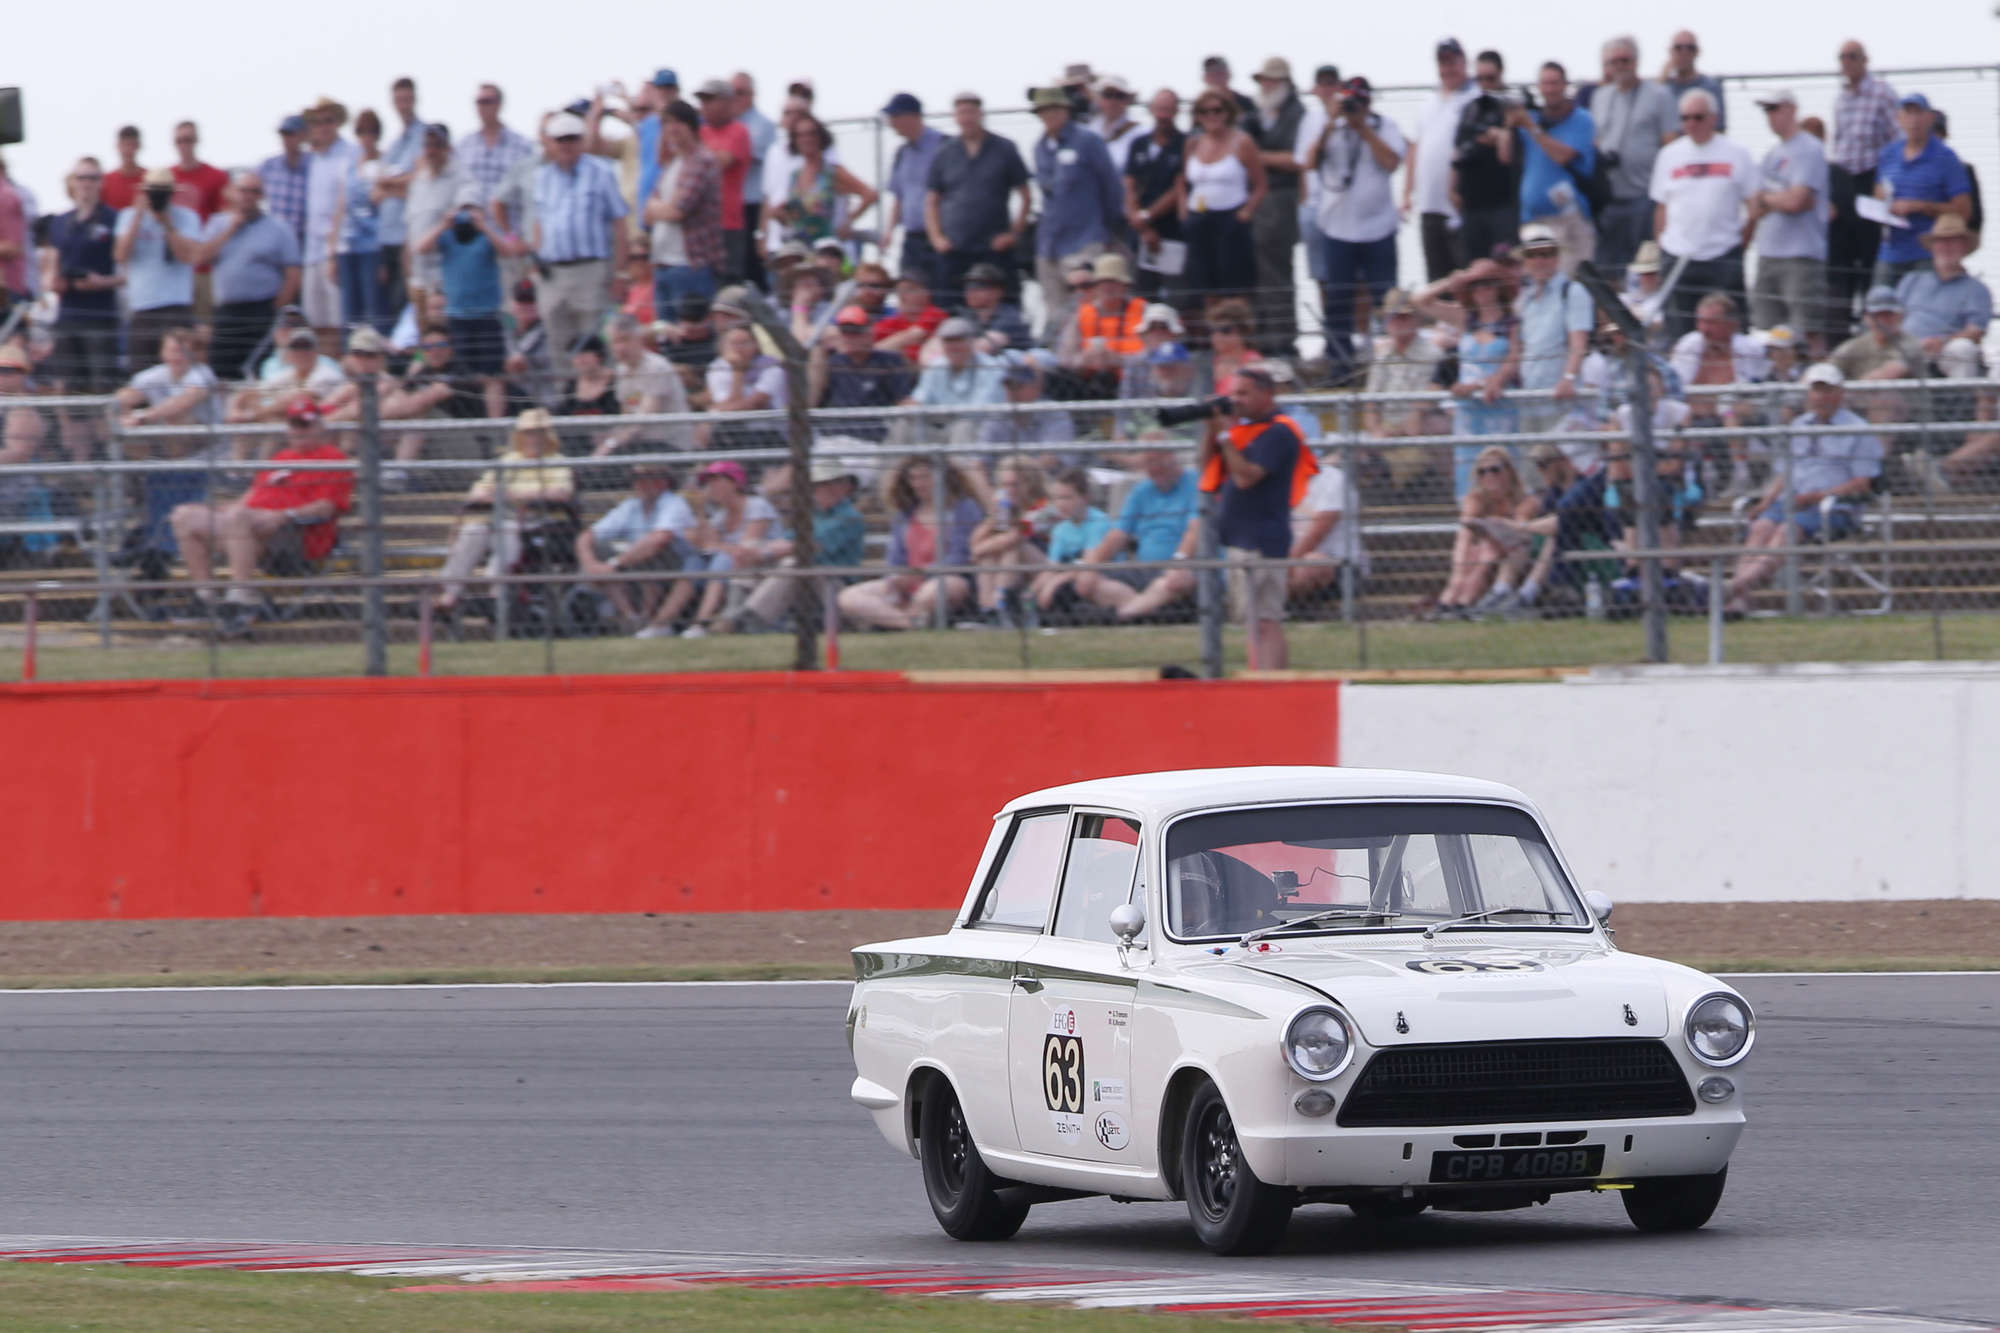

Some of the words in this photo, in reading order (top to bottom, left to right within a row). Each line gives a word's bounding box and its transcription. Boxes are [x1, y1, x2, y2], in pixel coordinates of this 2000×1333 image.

[1054, 1013, 1067, 1029] EFG
[1045, 1036, 1081, 1112] 63
[1056, 1122, 1081, 1135] ZENITH
[1447, 1155, 1504, 1178] CPB
[1512, 1150, 1588, 1176] 408B
